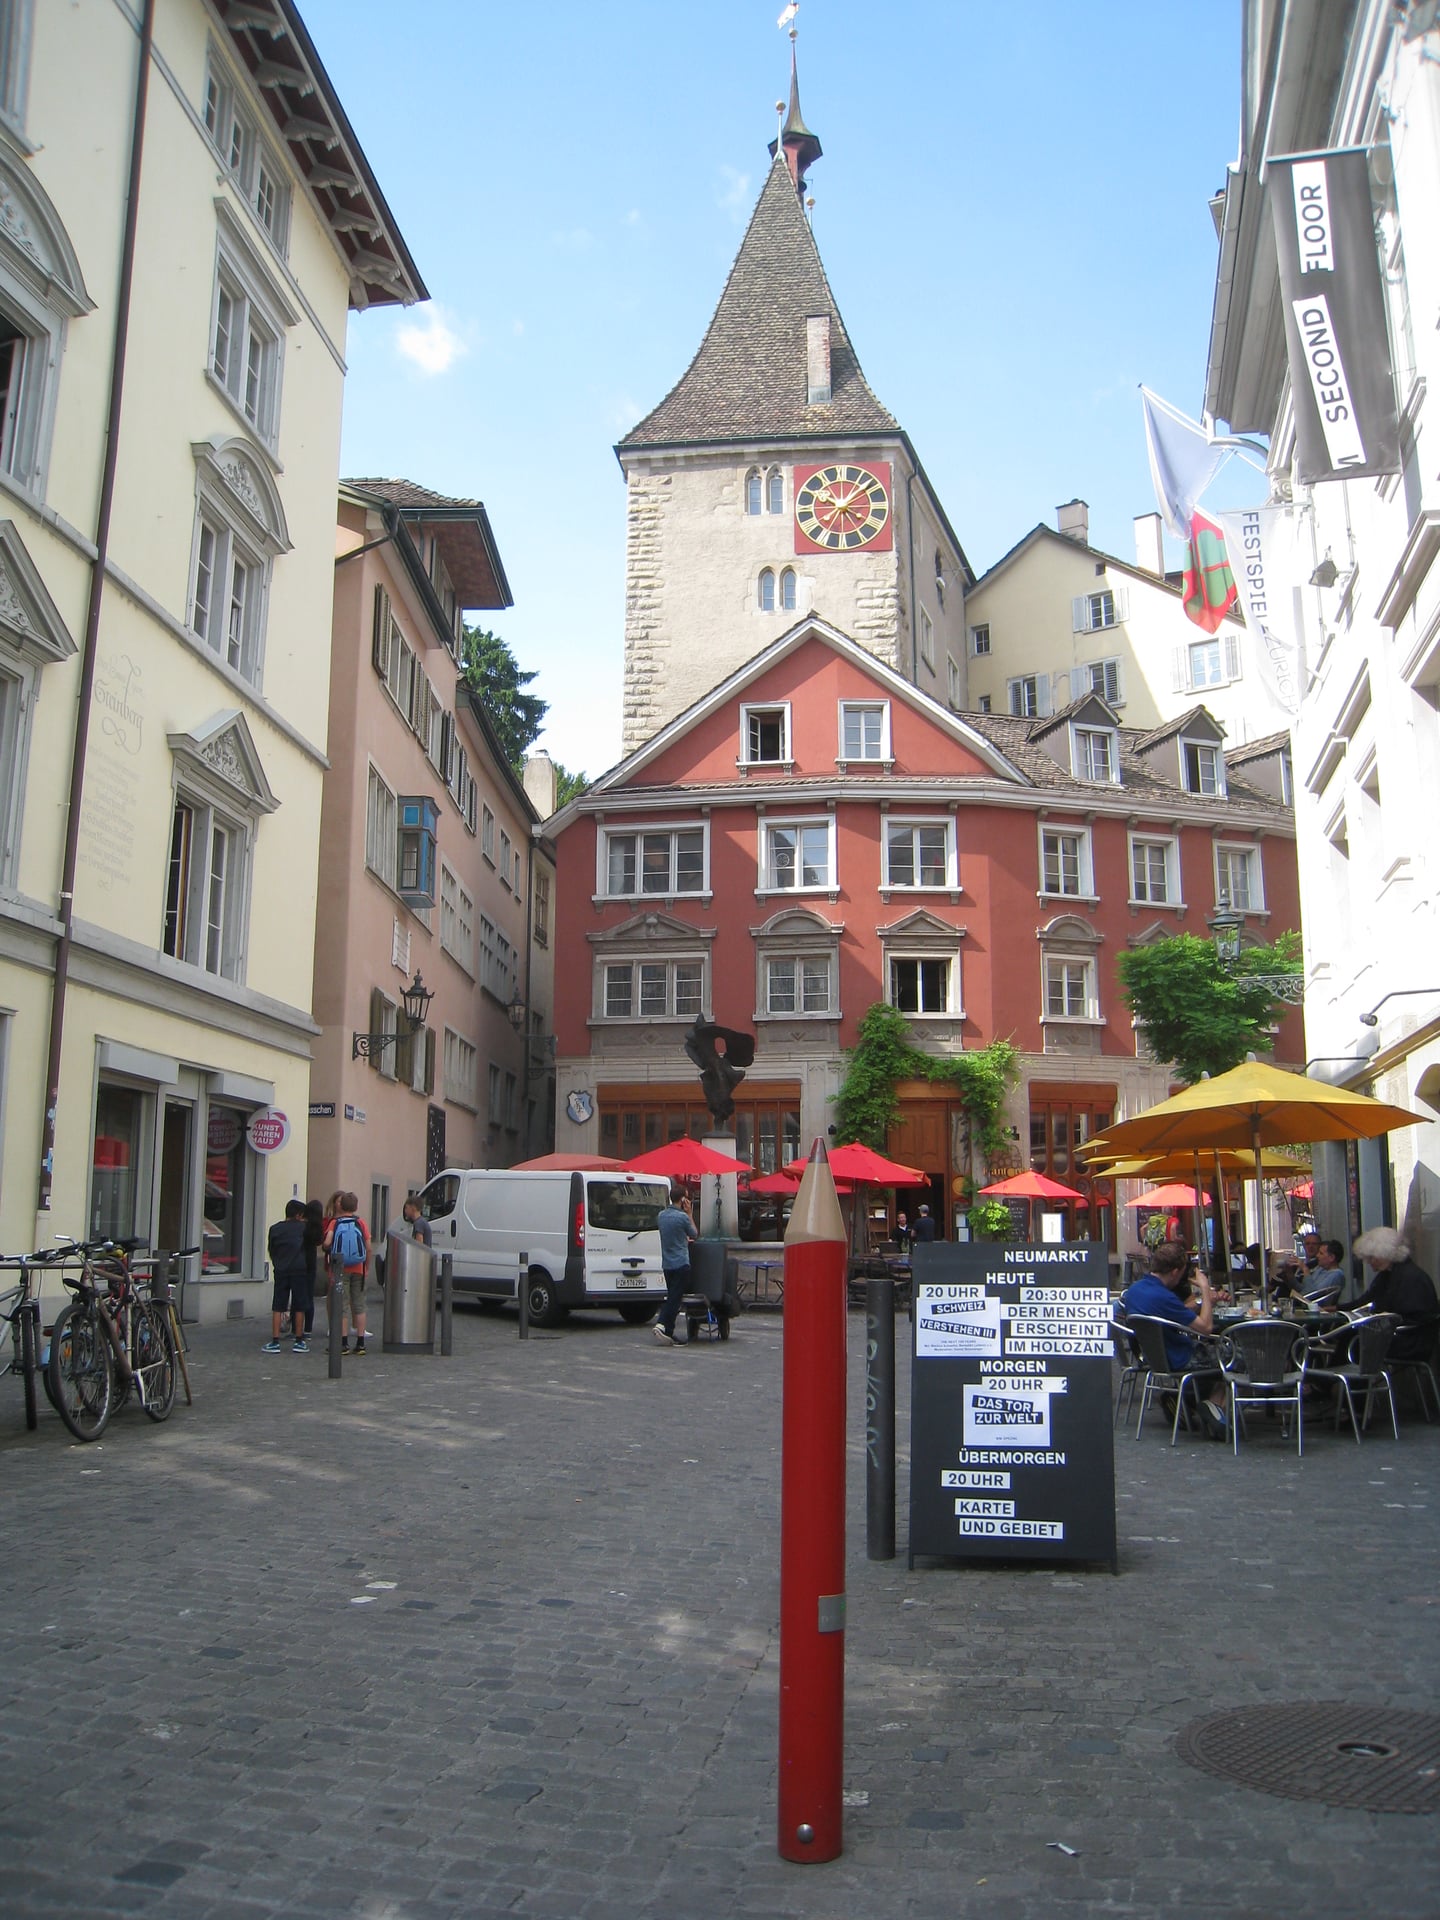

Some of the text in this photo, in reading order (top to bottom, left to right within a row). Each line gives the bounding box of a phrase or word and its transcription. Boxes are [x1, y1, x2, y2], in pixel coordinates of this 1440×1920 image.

[1300, 185, 1329, 272] FLOOR
[1302, 308, 1349, 423] SECOND
[1004, 1250, 1088, 1263] NEUMARKT
[986, 1272, 1035, 1284] HEUTE
[926, 1287, 979, 1298] 20 UHR
[1026, 1290, 1103, 1301] 20:30 UHR
[936, 1301, 984, 1314] SCHWEIZ
[1008, 1307, 1108, 1318] DER MENSCH
[921, 1319, 993, 1338] VERSTEHEN III
[1016, 1323, 1103, 1336] ERSCHEINT
[1009, 1338, 1104, 1353] IM HOLOZÄN
[980, 1360, 1047, 1373] MORGEN
[989, 1379, 1007, 1390] 20
[1011, 1379, 1043, 1391] UHR
[977, 1397, 1032, 1412] DAS TOR
[976, 1413, 1039, 1424] ZUR WELT
[959, 1447, 1065, 1464] ÜBERMORGEN
[948, 1473, 1004, 1486] 20 UHR
[960, 1501, 1011, 1514] KARTE
[962, 1521, 1057, 1537] UND GEBIET
